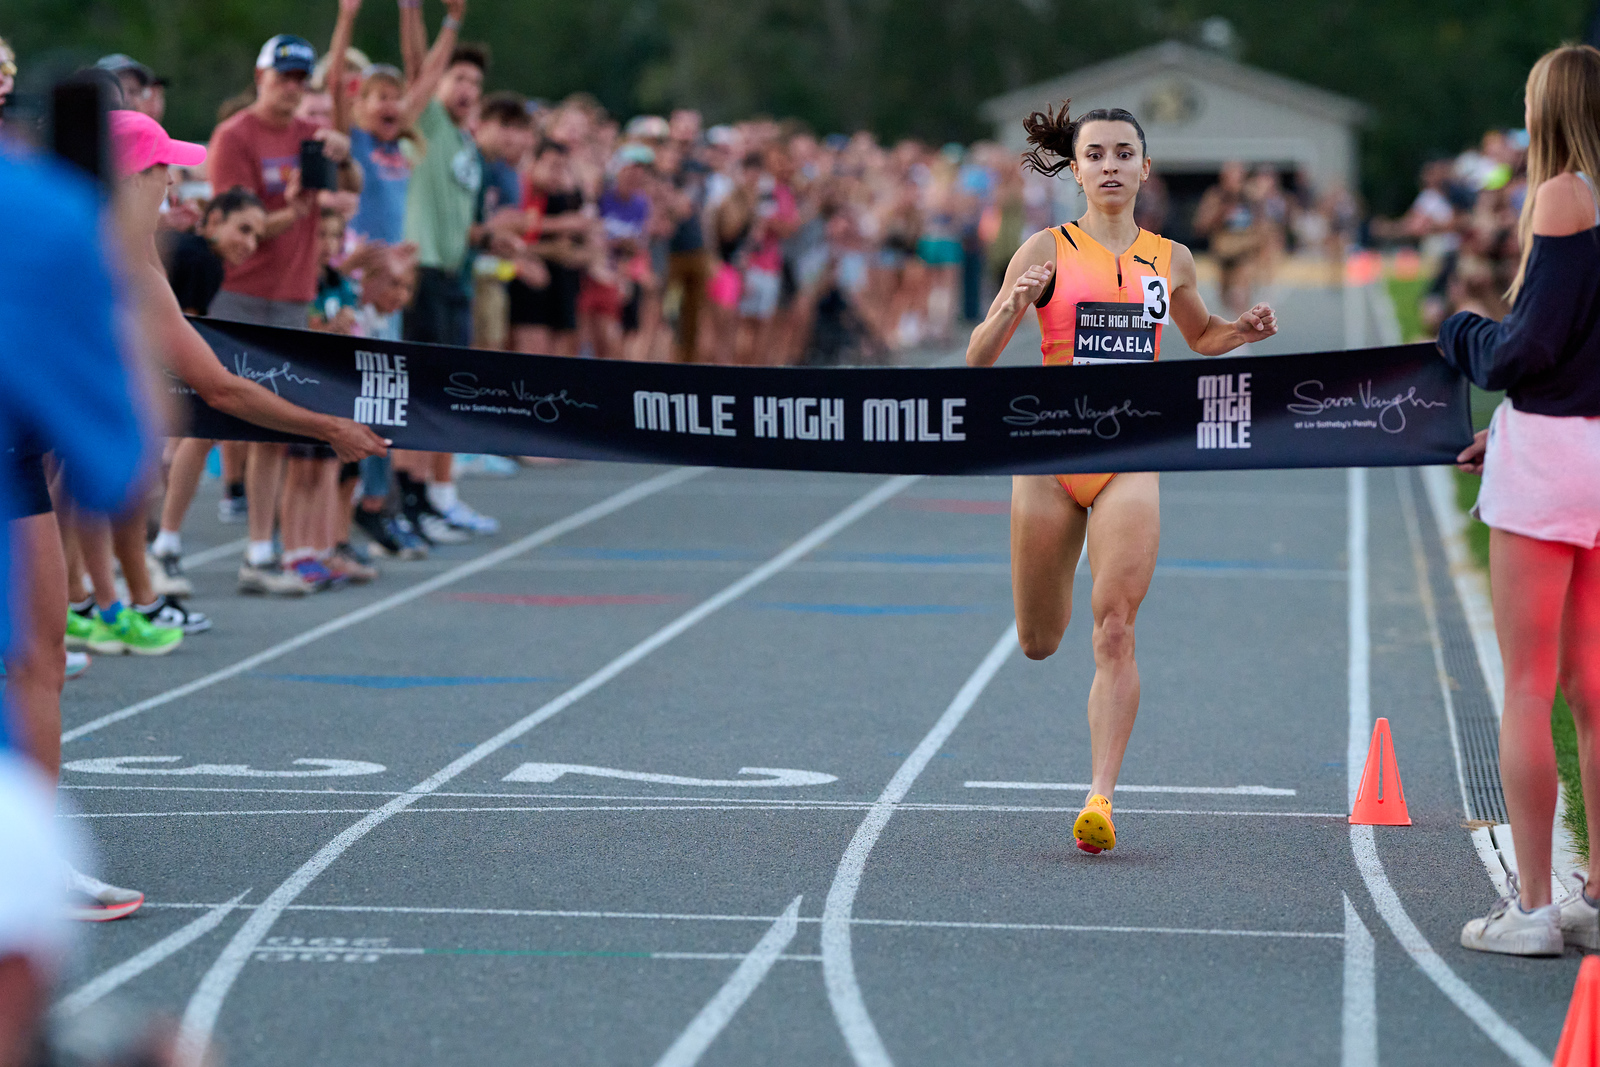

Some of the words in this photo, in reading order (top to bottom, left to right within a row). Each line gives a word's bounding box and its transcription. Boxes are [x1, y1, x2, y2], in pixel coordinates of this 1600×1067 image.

[1148, 280, 1167, 320] 3
[1078, 334, 1153, 354] MICAELA
[443, 371, 510, 400] Sara
[1286, 379, 1357, 415] Sara
[450, 403, 459, 411] at
[472, 403, 507, 414] Sotheby's
[507, 406, 532, 416] Realty
[1002, 394, 1072, 426] Sara
[1294, 421, 1303, 429] at
[1315, 420, 1351, 430] Sotheby's
[1352, 420, 1378, 429] Realty
